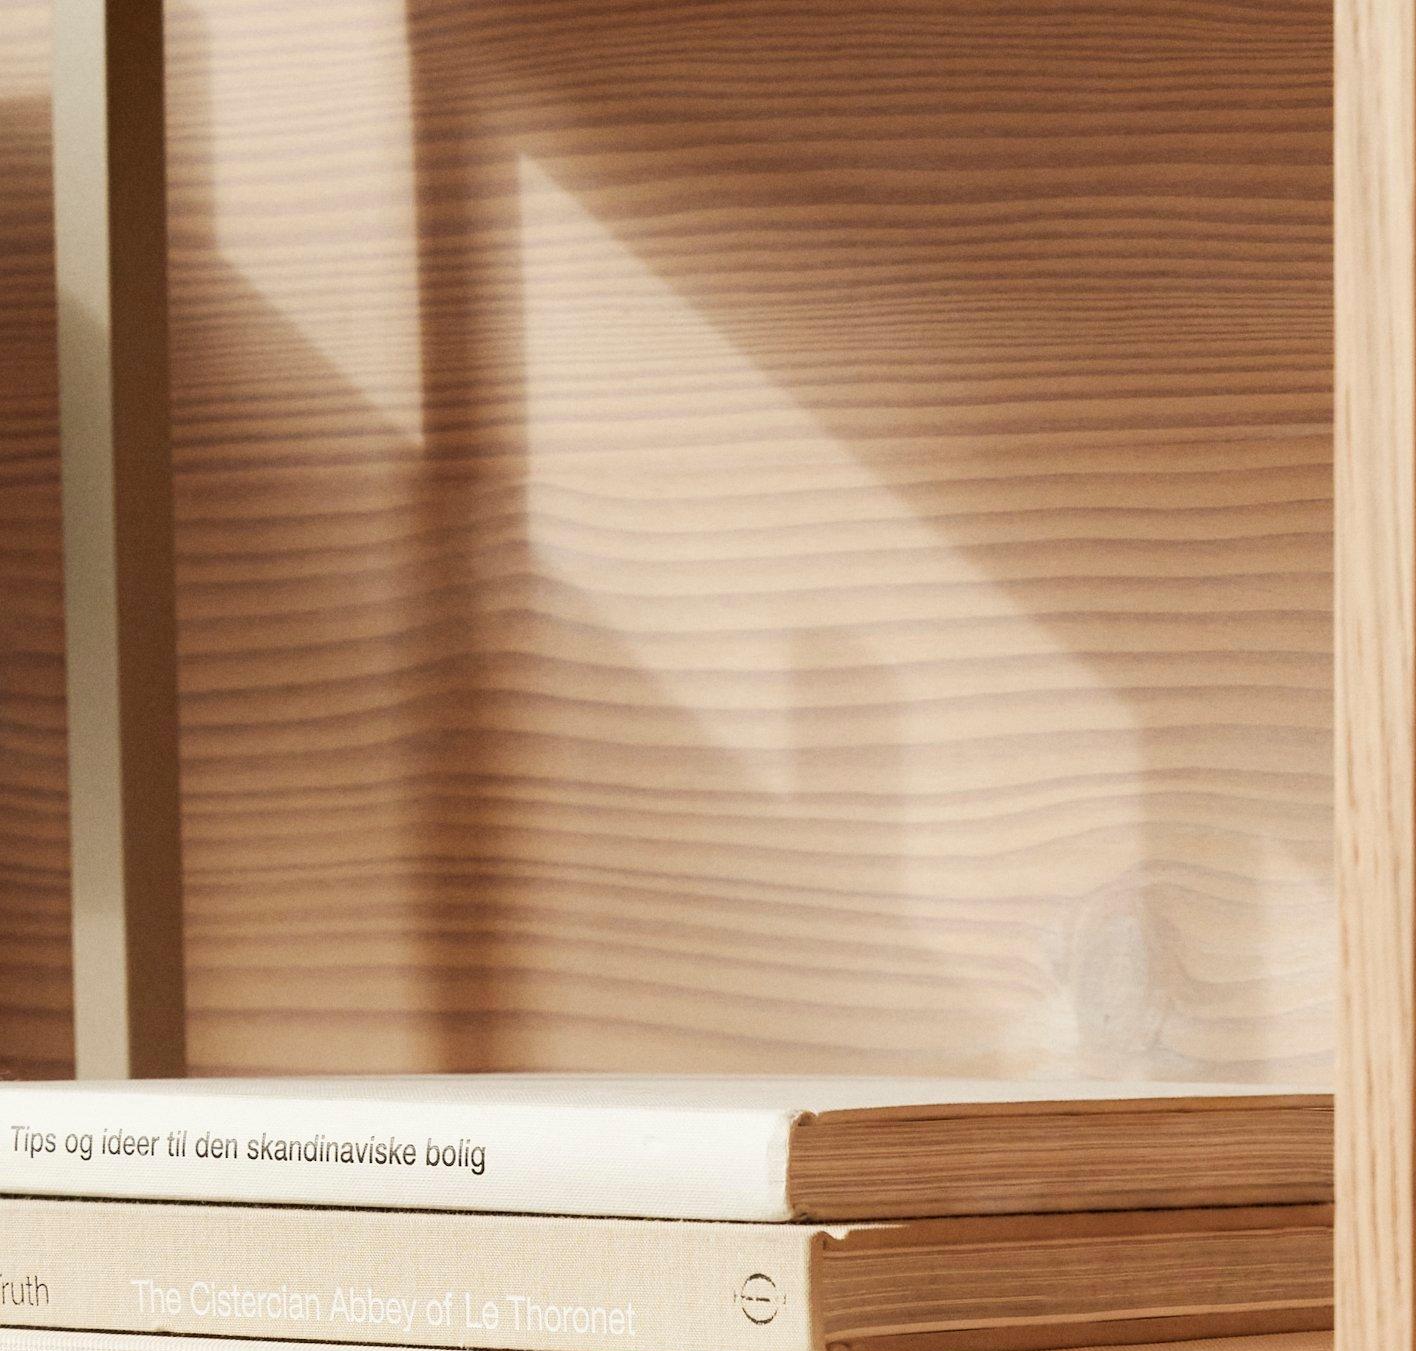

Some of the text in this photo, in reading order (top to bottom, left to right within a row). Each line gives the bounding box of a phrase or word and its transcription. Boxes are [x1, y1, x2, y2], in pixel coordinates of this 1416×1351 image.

[10, 1125, 486, 1176] Tips og ideer til den skandinaviske bolig
[0, 1274, 637, 1336] ruth The Cistercian Abbey of Le Thoronet
